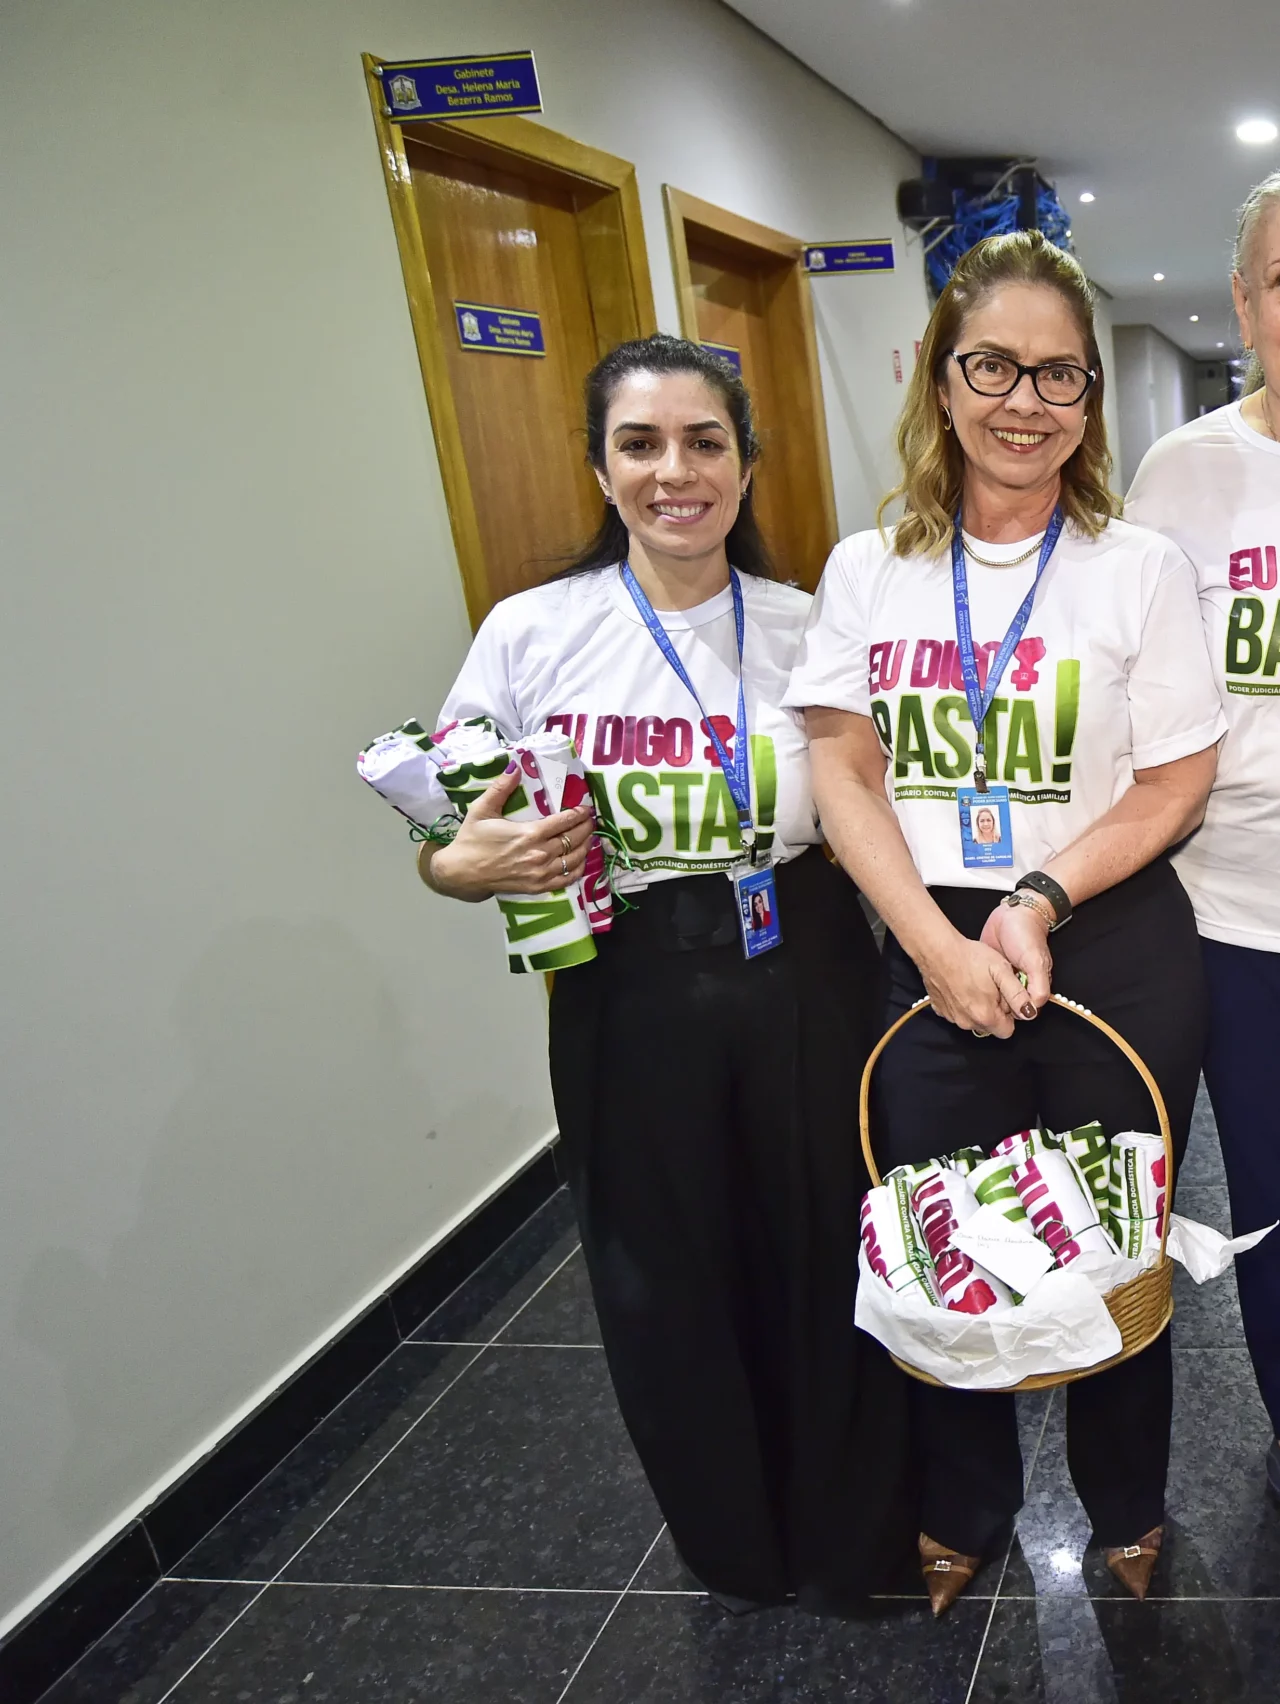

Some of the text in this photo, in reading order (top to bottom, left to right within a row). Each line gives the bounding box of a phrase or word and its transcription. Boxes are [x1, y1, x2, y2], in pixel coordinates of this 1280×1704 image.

[453, 68, 494, 80] Gabinete
[435, 79, 521, 95] Desa. Helena Maria
[447, 92, 514, 107] Bezerra Ramos
[1229, 546, 1278, 591] EU
[869, 639, 907, 695] EU
[990, 660, 1002, 678] PODER
[1229, 685, 1250, 693] PODER
[592, 714, 694, 767] DIGO
[584, 734, 778, 852] ASTA!
[1008, 793, 1036, 802] MÉSTICA
[690, 861, 732, 870] DOMÉSTICA
[1127, 1158, 1137, 1197] DOMÉSTICA
[897, 1178, 907, 1207] DICIÁRIO
[901, 1205, 911, 1230] CONTRA
[1131, 1199, 1140, 1233] VIOÊNCIA
[1131, 1242, 1139, 1260] NTRA
